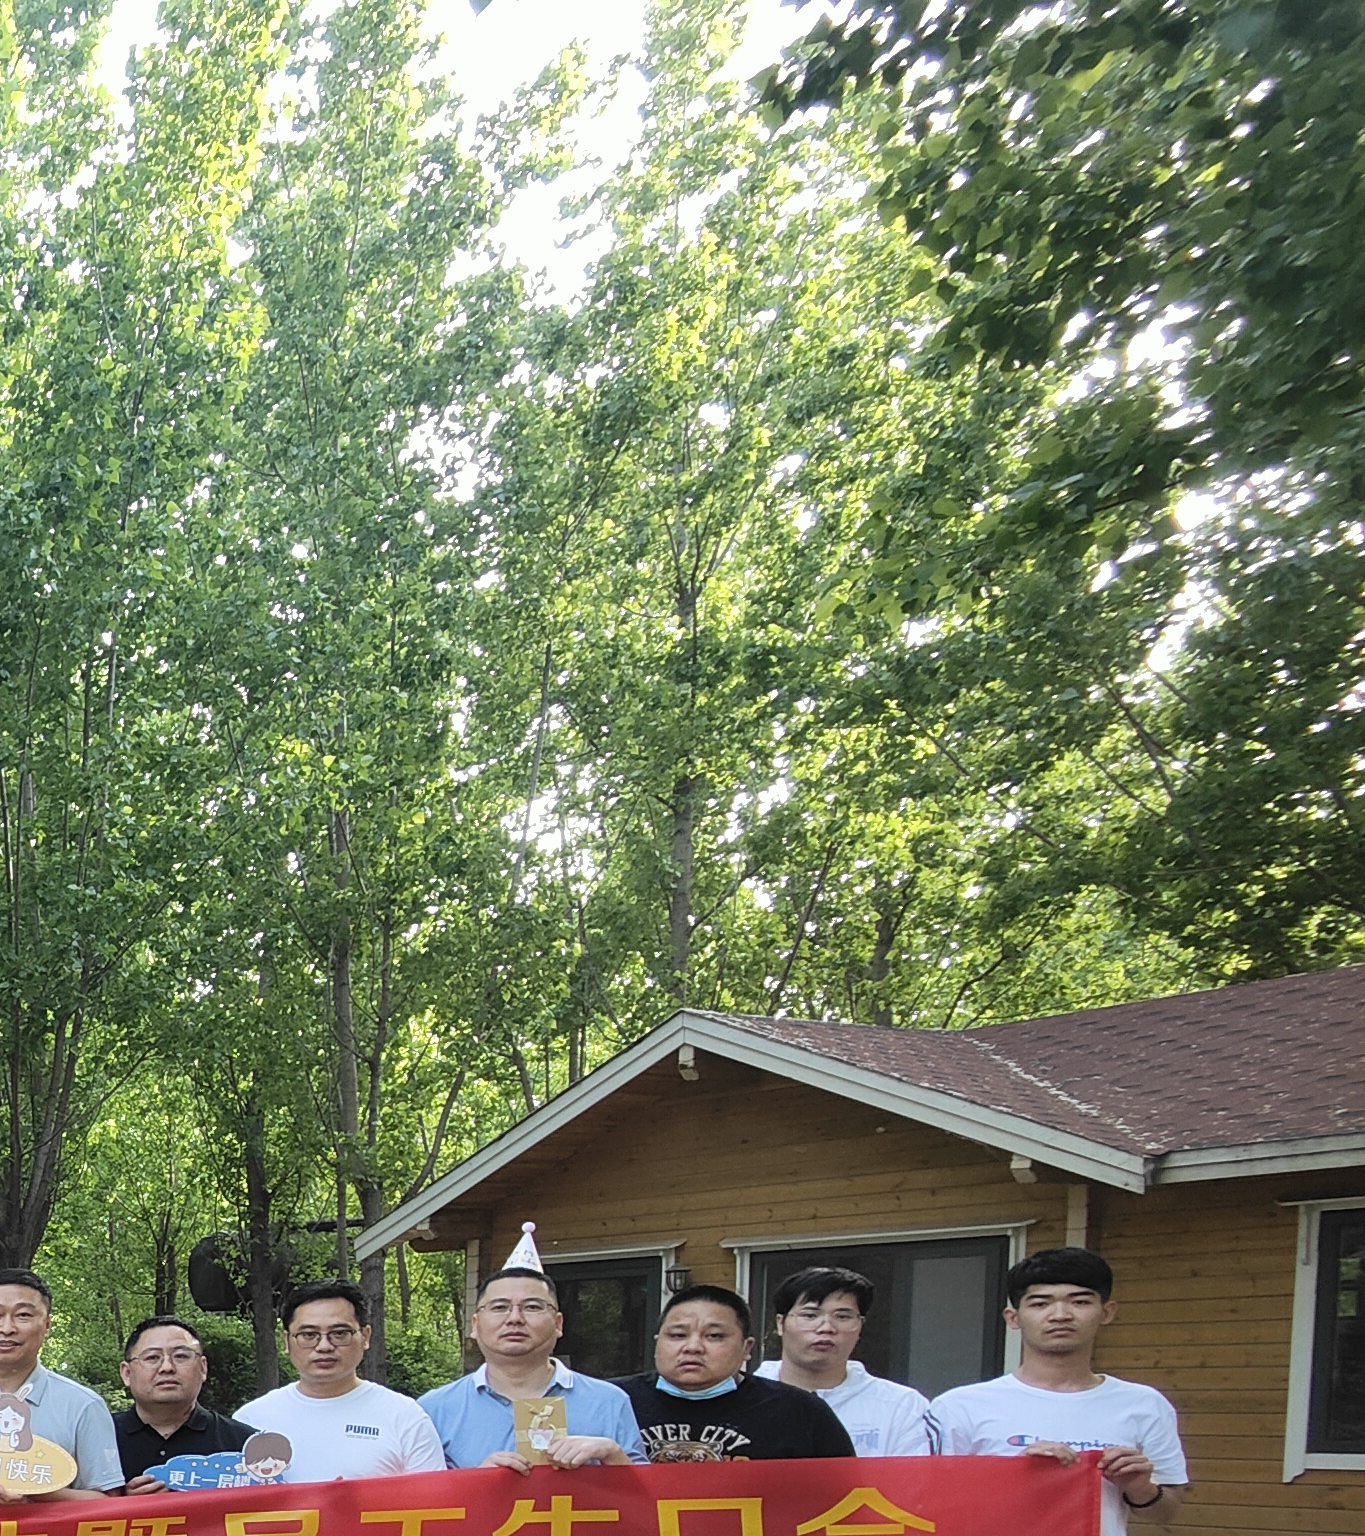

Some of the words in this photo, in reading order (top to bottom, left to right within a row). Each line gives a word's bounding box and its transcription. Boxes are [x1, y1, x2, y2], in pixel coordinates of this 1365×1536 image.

[345, 1424, 380, 1436] PUMA
[640, 1423, 691, 1446] IVER
[699, 1425, 751, 1451] CITY
